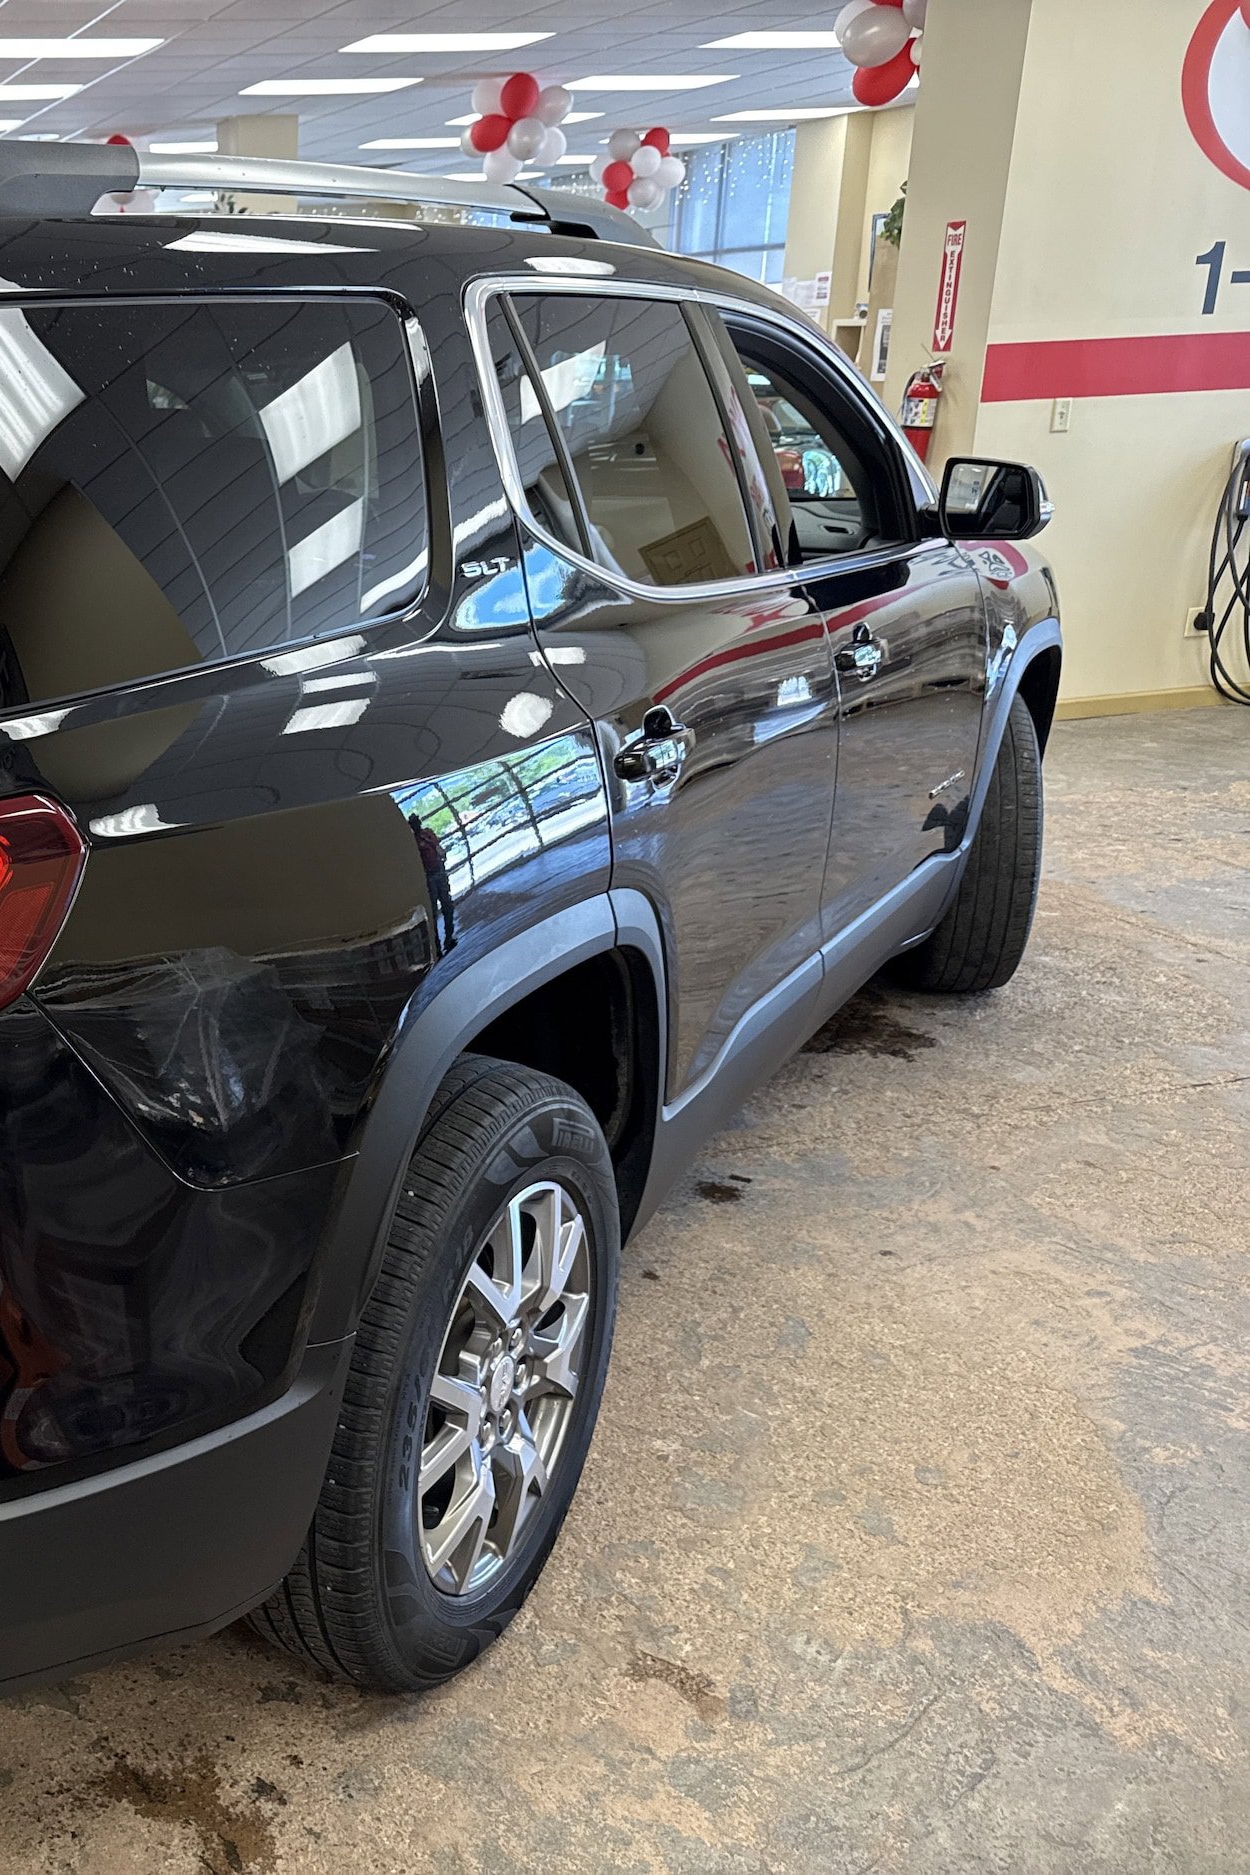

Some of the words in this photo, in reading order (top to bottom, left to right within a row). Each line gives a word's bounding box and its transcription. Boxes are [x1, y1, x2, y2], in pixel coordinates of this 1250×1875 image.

[947, 233, 962, 246] FIRE
[939, 250, 956, 342] EXTINGUISHER
[461, 556, 510, 577] SLT
[551, 1117, 595, 1153] PIRELLI
